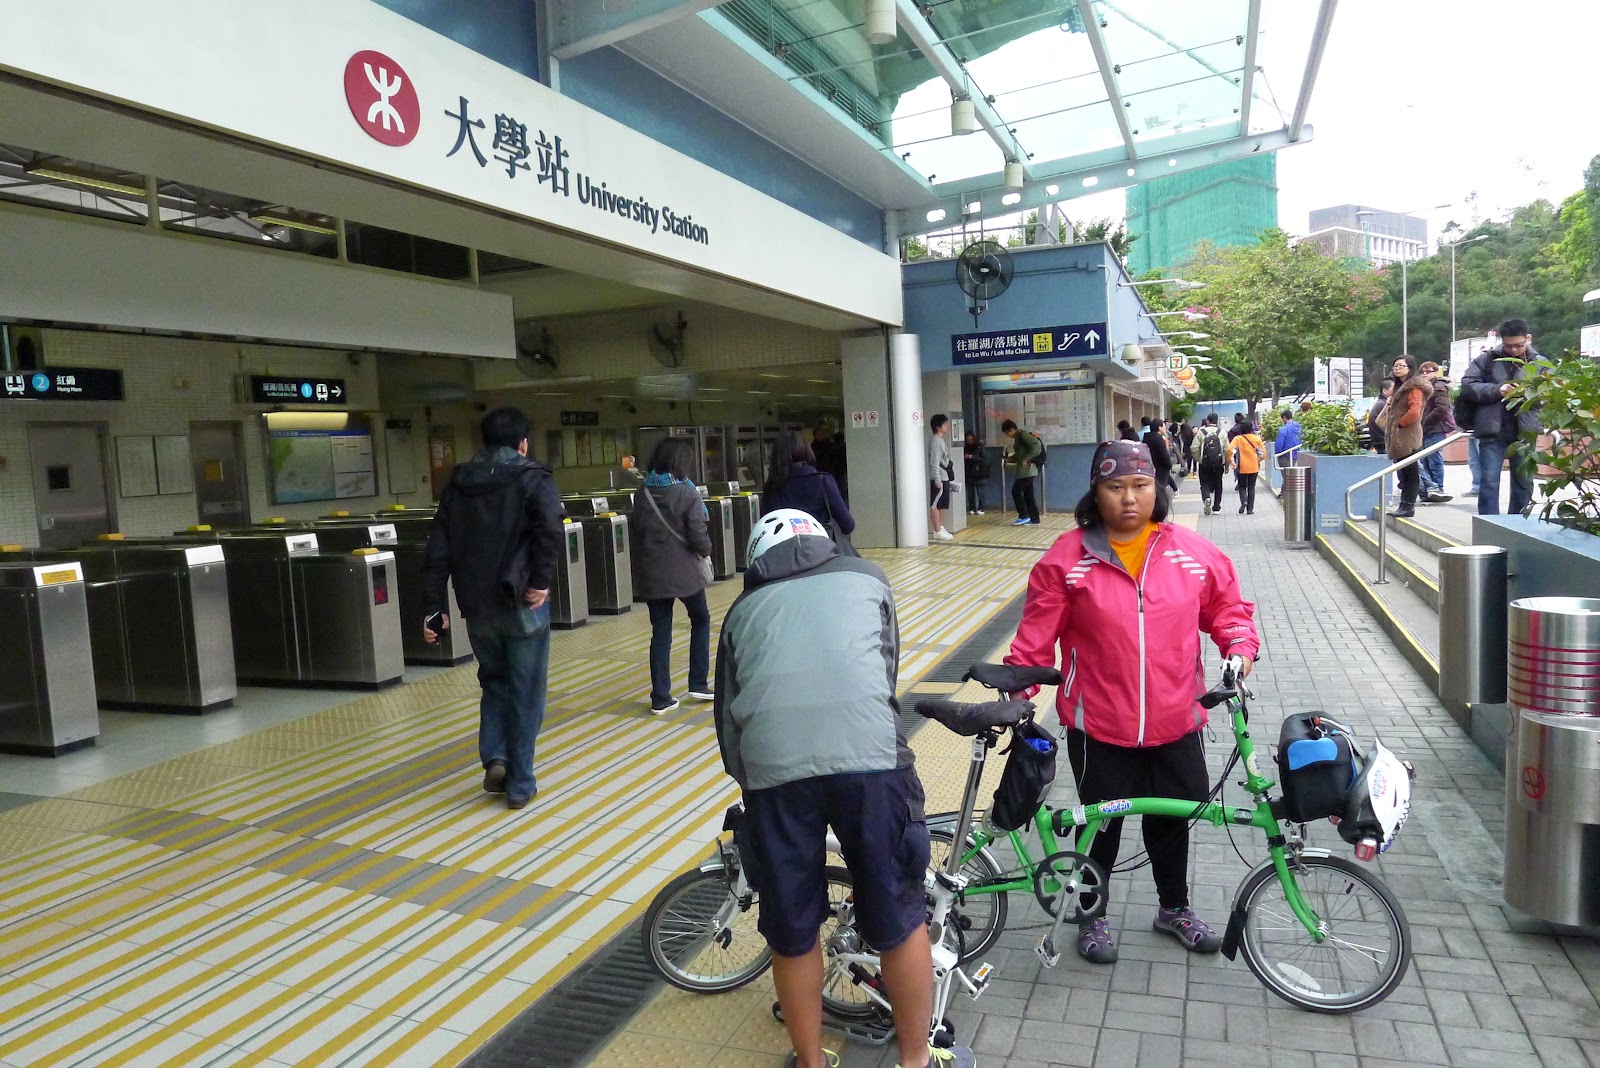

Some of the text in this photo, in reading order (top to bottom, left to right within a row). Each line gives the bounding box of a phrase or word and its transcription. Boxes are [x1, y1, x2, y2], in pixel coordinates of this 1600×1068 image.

[444, 95, 571, 197] 大學站
[577, 172, 709, 246] University Station
[36, 376, 45, 388] 2
